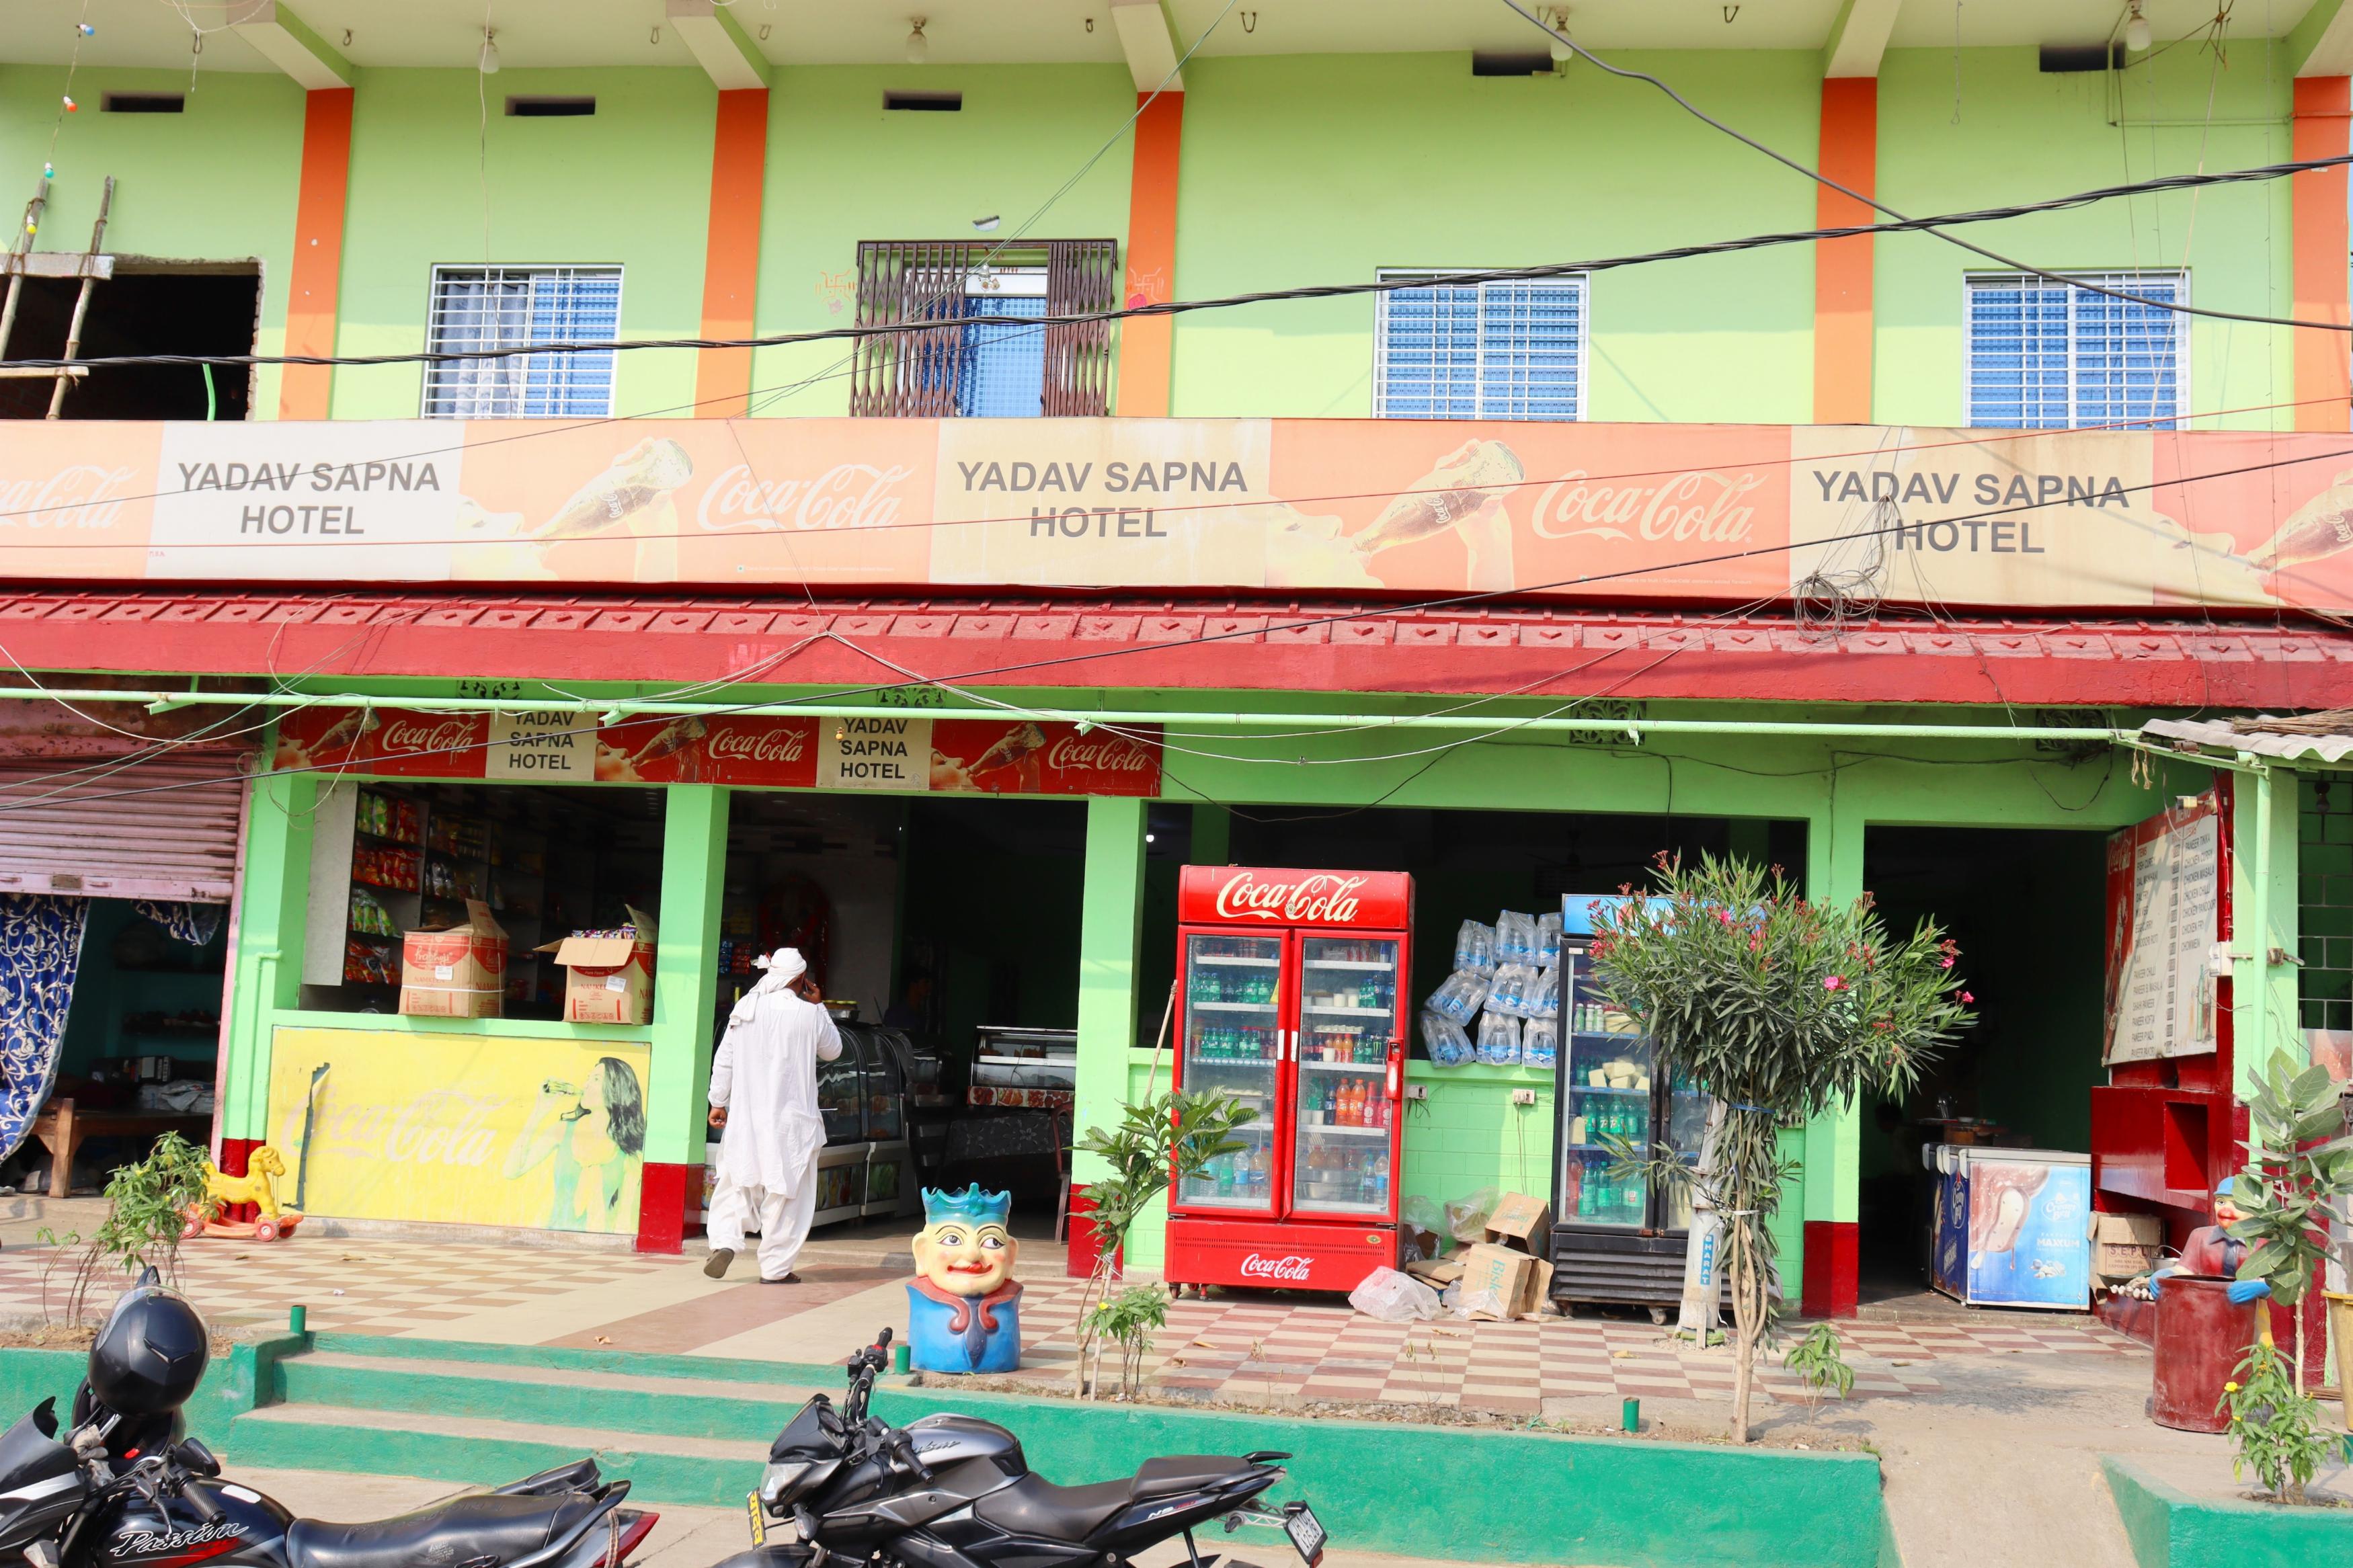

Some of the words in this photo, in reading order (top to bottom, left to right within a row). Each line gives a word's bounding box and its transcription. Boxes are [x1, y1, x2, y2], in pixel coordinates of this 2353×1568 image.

[177, 462, 301, 492] YADAV
[313, 462, 441, 492] SAPNA
[957, 462, 1092, 492] YADAV
[1105, 461, 1248, 493] SAPNA
[1812, 470, 1960, 504] YADAV
[1974, 472, 2130, 508] SAPNA
[697, 463, 919, 532] Coca-Cola
[1531, 469, 1769, 543] Coca-Cola
[240, 505, 366, 535] HOTEL
[1030, 507, 1168, 538] HOTEL
[1896, 519, 2045, 554] HOTEL
[513, 710, 573, 727] YADAV
[843, 718, 909, 735] YADAV
[382, 720, 479, 753] Coca-Cola
[510, 732, 574, 749] SAPNA
[708, 727, 808, 763] Coca-Cola
[840, 740, 908, 757] SAPNA
[508, 753, 571, 770] HOTEL
[1049, 736, 1148, 772] Coca-Cola
[840, 762, 906, 780] HOTEL
[2183, 870, 2199, 885] CHICKEN
[2199, 864, 2215, 879] MASALA
[1216, 871, 1369, 923] Coca-Cola
[2183, 887, 2198, 901] CHICKEN
[2182, 904, 2198, 919] CHICKEN
[2182, 921, 2197, 936] CHICKEN
[281, 1084, 511, 1167] Coca-Cola
[1240, 1253, 1314, 1280] Coca-Cola
[1702, 1235, 1713, 1284] BHARAT
[914, 1441, 961, 1455] ulsar
[109, 1522, 250, 1557] Passion
